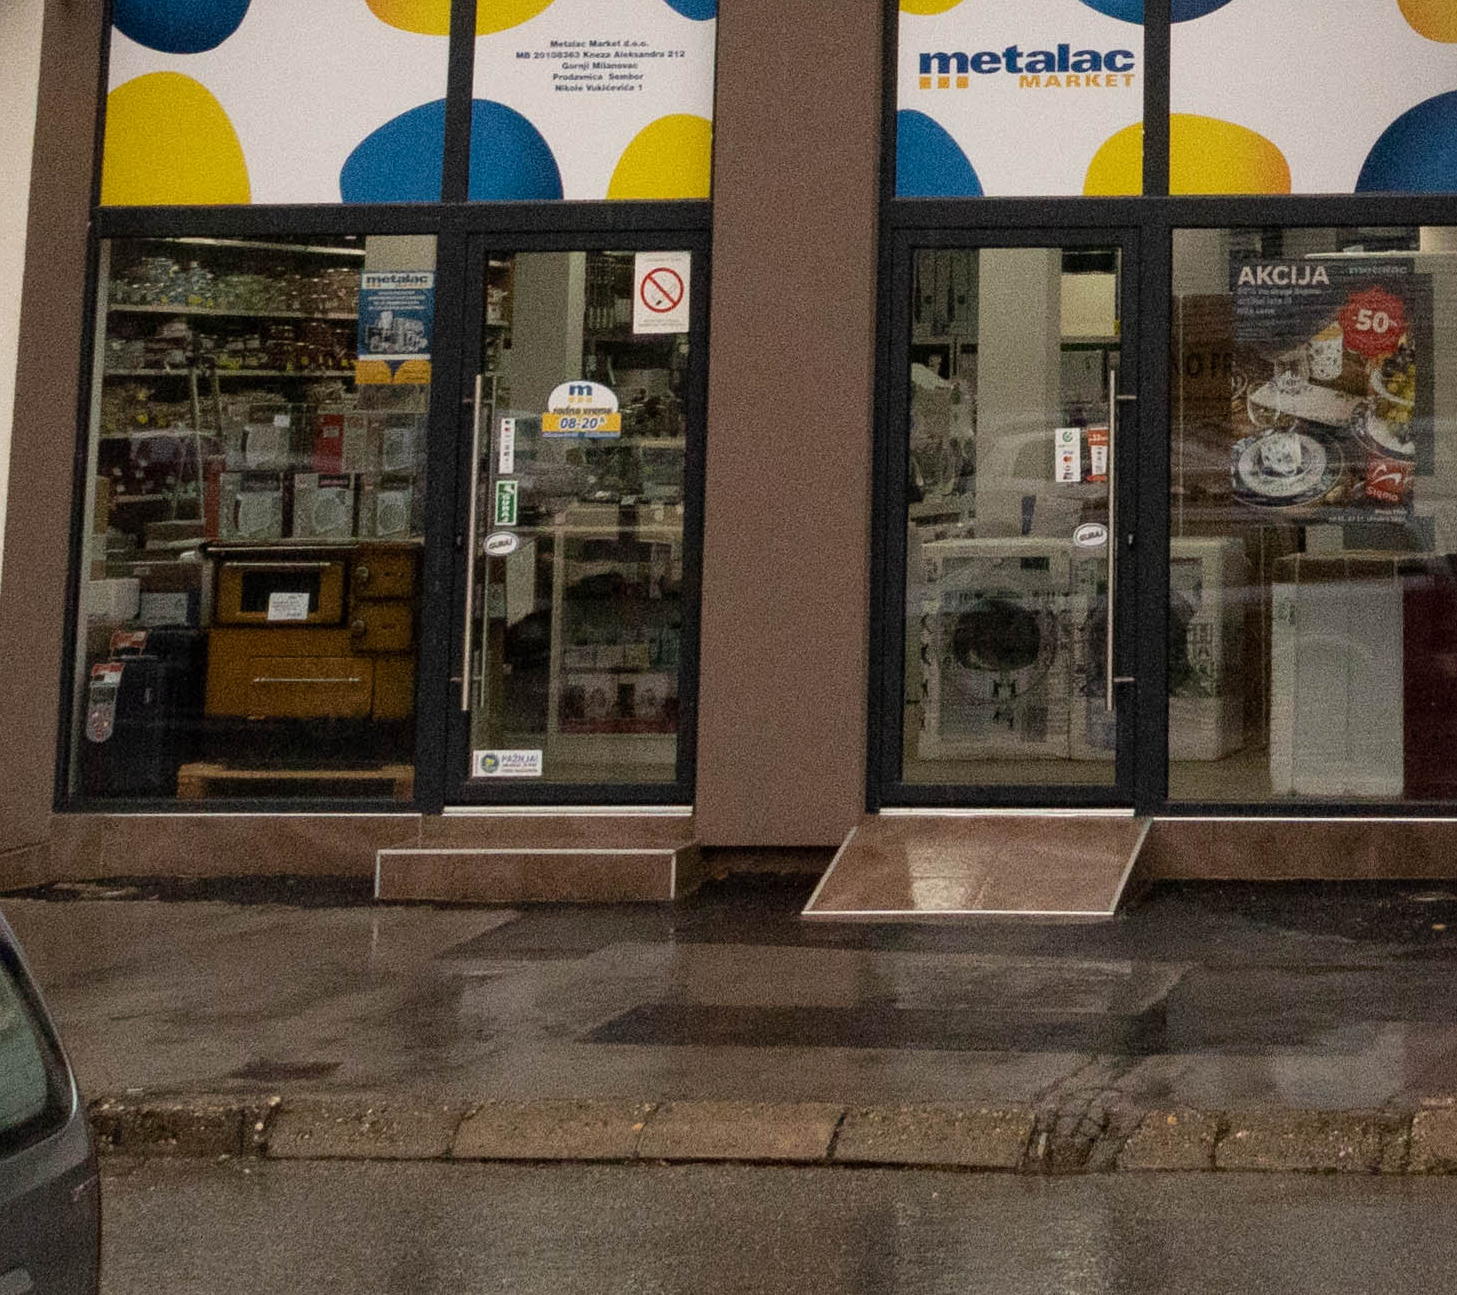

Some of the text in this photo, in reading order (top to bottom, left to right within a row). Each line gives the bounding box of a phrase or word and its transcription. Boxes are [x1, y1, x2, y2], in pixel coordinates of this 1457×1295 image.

[550, 40, 586, 48] Metalac
[589, 40, 621, 48] Market
[614, 50, 665, 58] Aleksandra
[667, 50, 686, 58] 212
[919, 43, 1135, 74] metalac
[1019, 74, 1135, 89] MARKET
[555, 84, 584, 92] Nikole
[366, 275, 429, 284] metalac
[1237, 265, 1330, 285] AKCIJA
